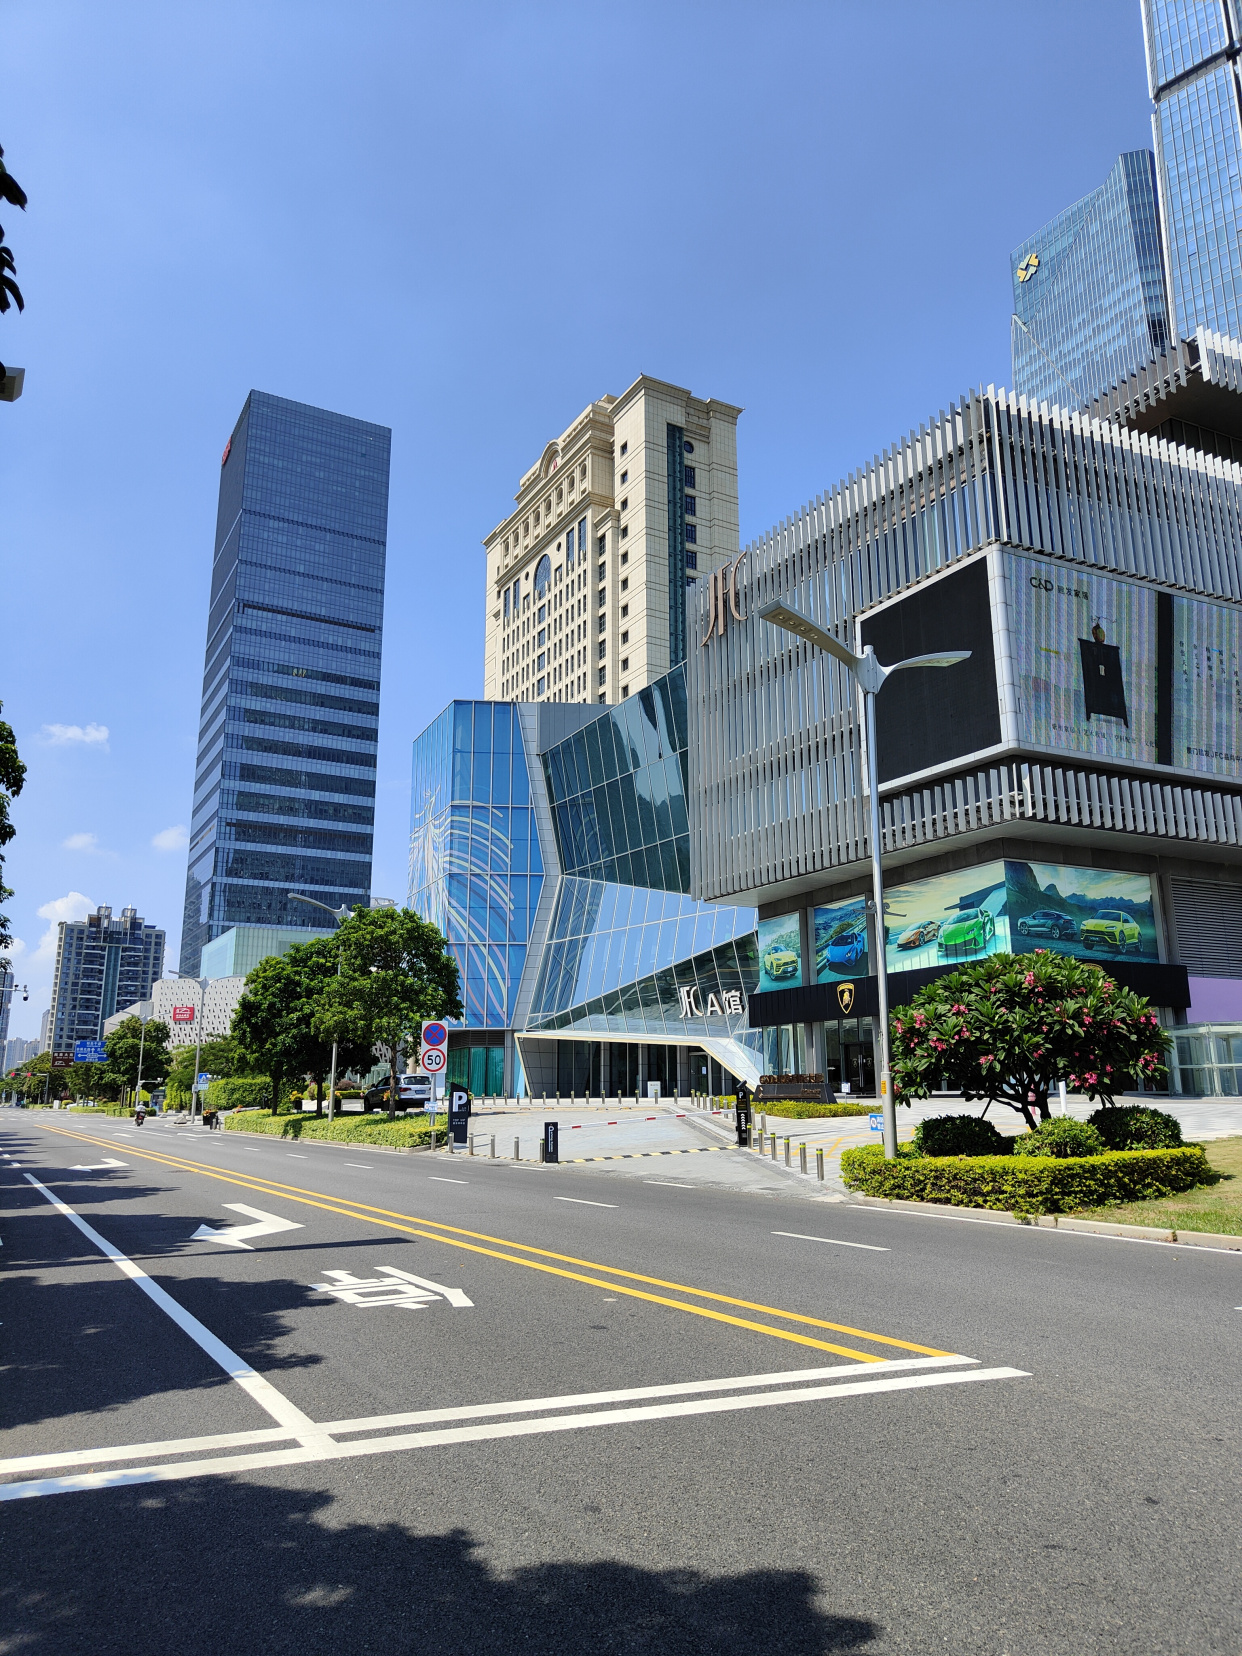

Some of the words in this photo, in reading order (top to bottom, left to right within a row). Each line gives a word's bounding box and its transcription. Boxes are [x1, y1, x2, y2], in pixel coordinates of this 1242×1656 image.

[1030, 577, 1054, 592] C&D
[700, 551, 748, 647] JFC
[679, 984, 704, 1018] JFC
[427, 1054, 441, 1066] 50
[453, 1091, 468, 1112] P
[739, 1091, 744, 1099] P
